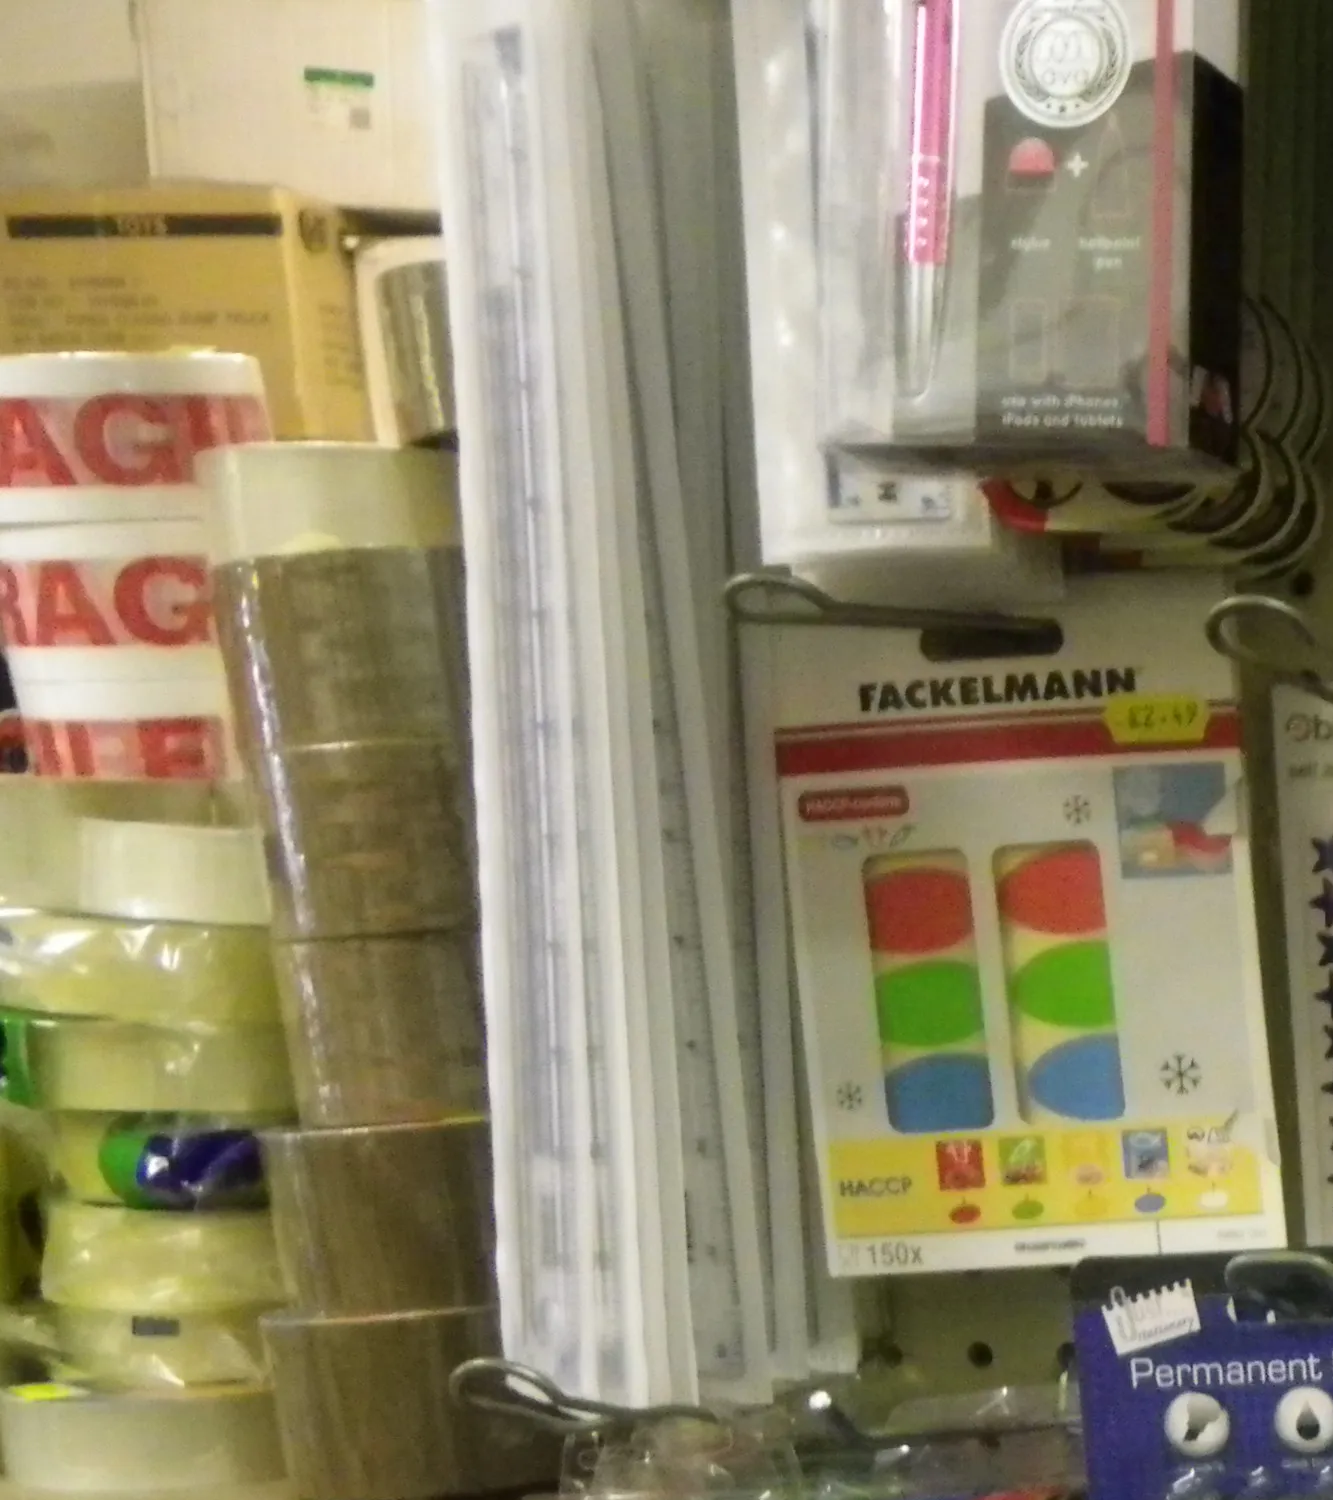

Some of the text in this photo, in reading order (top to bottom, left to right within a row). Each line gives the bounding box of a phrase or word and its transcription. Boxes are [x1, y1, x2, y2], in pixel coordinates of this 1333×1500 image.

[858, 667, 1136, 713] FACKELMANN
[839, 1177, 913, 1197] HACCP
[867, 1241, 924, 1265] 150x
[1130, 1355, 1323, 1389] Permanent
